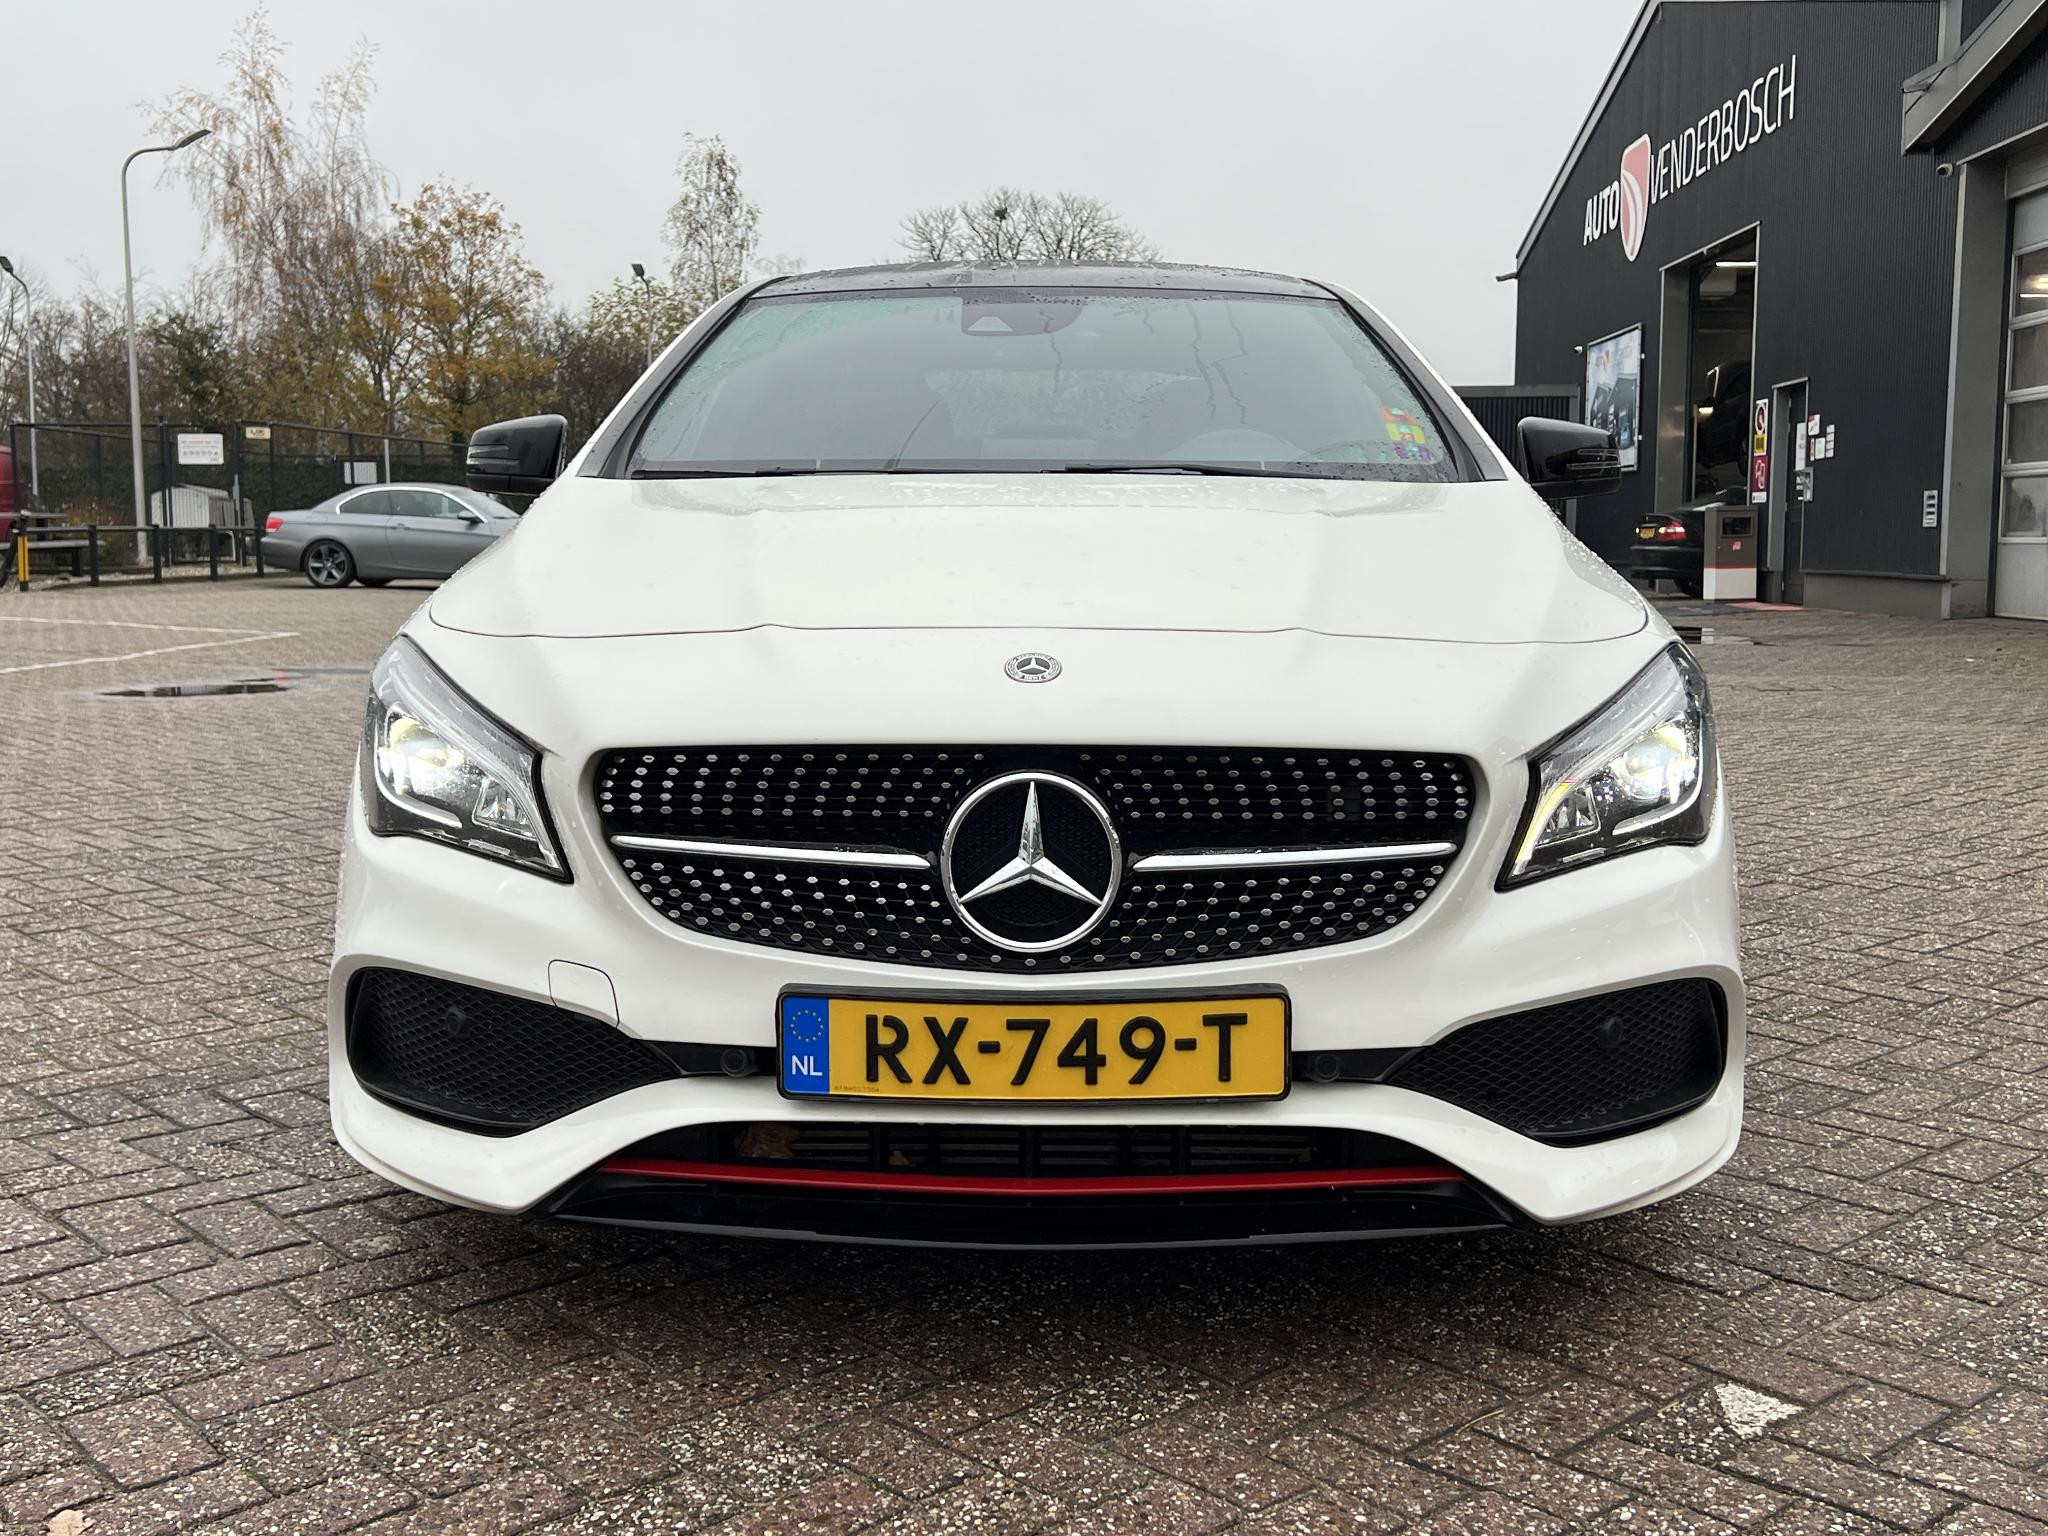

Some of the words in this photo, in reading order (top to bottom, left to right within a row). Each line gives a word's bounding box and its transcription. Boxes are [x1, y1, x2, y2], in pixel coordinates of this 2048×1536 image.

[1583, 180, 1620, 246] AUTO
[1649, 54, 1797, 205] VENDERBOSCH
[791, 1054, 823, 1077] NL
[864, 1012, 1249, 1086] RX-749-T
